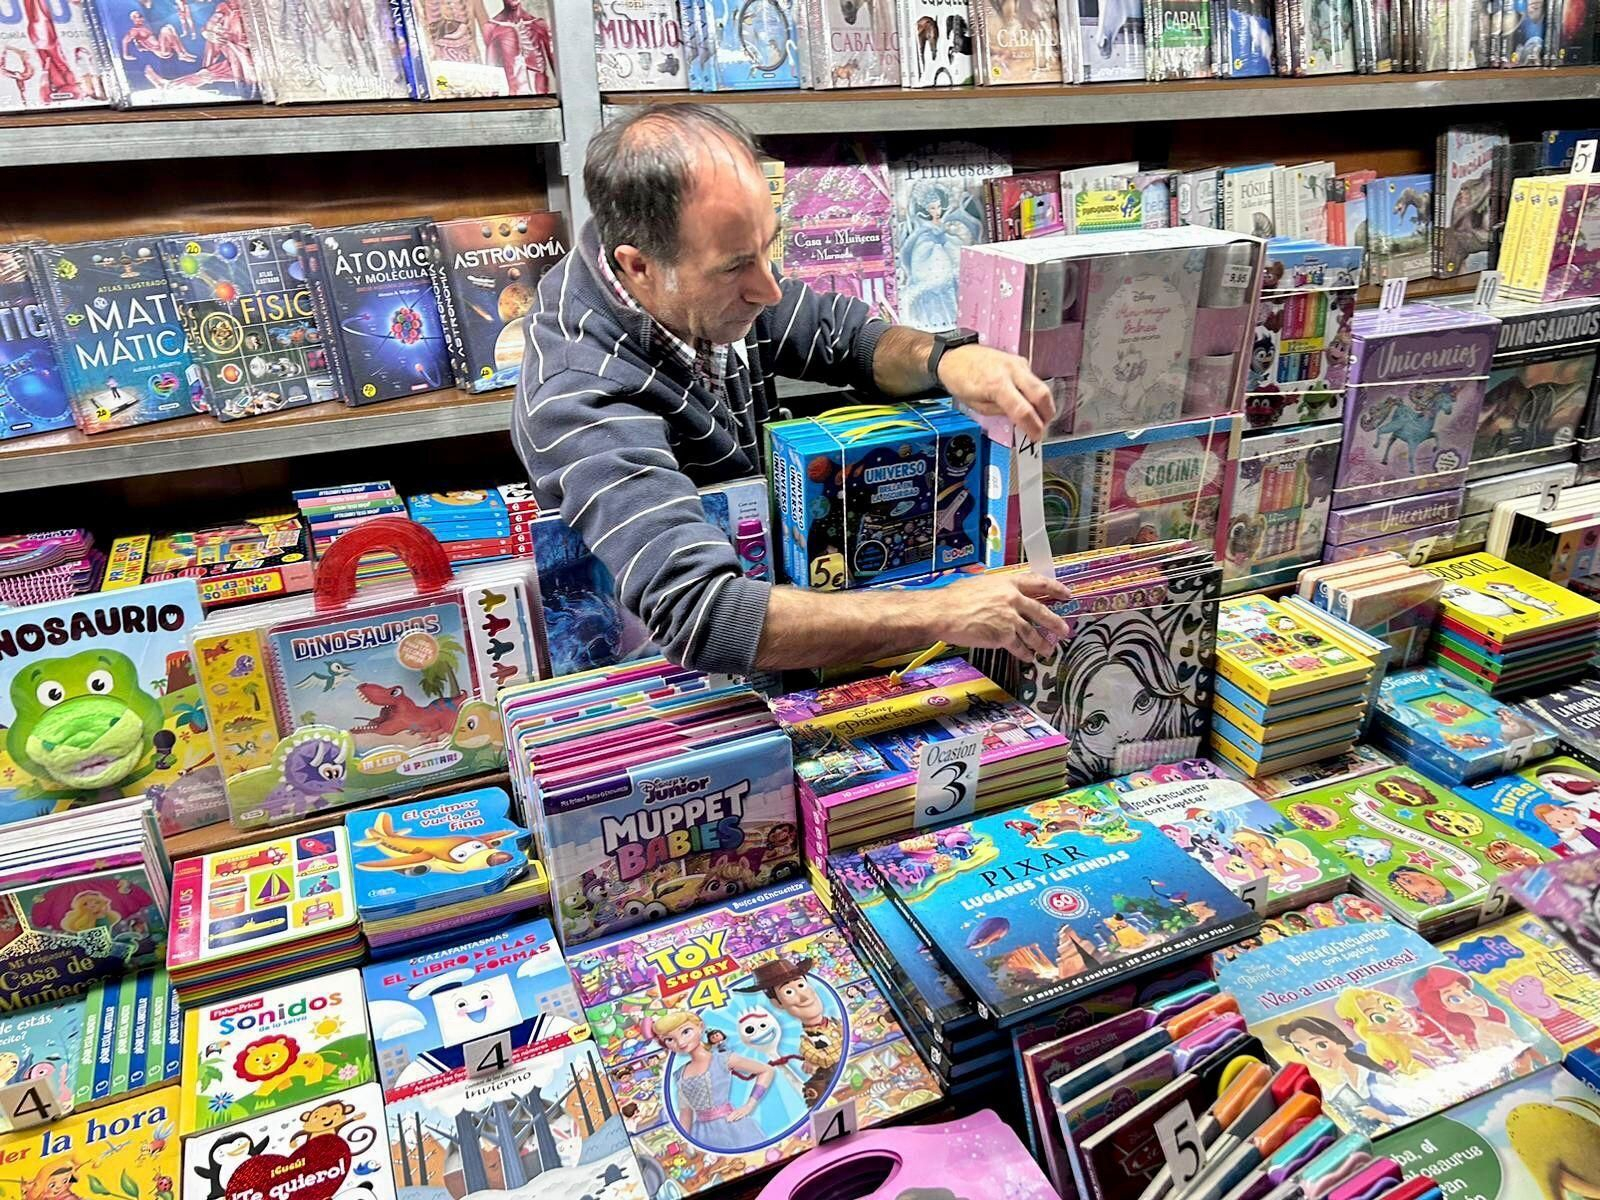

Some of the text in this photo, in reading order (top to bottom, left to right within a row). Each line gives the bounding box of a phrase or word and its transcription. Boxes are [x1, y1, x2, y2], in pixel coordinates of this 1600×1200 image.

[903, 158, 995, 181] Princesas
[454, 237, 566, 270] ASTRONOMÍA
[794, 231, 822, 248] Casa
[364, 267, 430, 285] MOLÉCULA
[240, 289, 314, 326] FÍSIC
[1386, 280, 1404, 309] 10
[1498, 311, 1600, 349] DINOSAURIOS
[1377, 341, 1481, 378] Unicornios
[864, 460, 926, 484] UNIVERSO
[203, 572, 272, 593] CONCEPTO
[0, 604, 185, 662] NOSAURIO
[836, 707, 921, 734] PRINCESA
[926, 740, 978, 767] Ocasion
[924, 761, 968, 816] 3
[402, 811, 418, 822] El
[603, 780, 749, 851] MUPPET
[617, 816, 744, 880] BABIES
[960, 879, 1037, 912] LUGARES
[1050, 850, 1131, 883] LEYENDAS
[979, 845, 1090, 889] PIXAR
[1051, 893, 1076, 910] 60
[382, 975, 407, 987] EL
[501, 933, 537, 952] LAS
[417, 931, 509, 963] CAZAFANTASMAS
[646, 929, 729, 978] TOY
[1486, 936, 1522, 961] Pig
[1, 955, 96, 991] Casa de
[665, 959, 730, 989] STORY
[1314, 974, 1346, 993] una
[1347, 948, 1419, 984] princesa!
[212, 999, 262, 1019] Fisher-Price
[688, 974, 731, 1012] 4
[219, 991, 344, 1036] Sonidos
[475, 1039, 511, 1074] 4
[13, 1087, 52, 1121] 4
[40, 1105, 168, 1159] la hora
[818, 1109, 852, 1146] 4
[1173, 1119, 1200, 1182] 5
